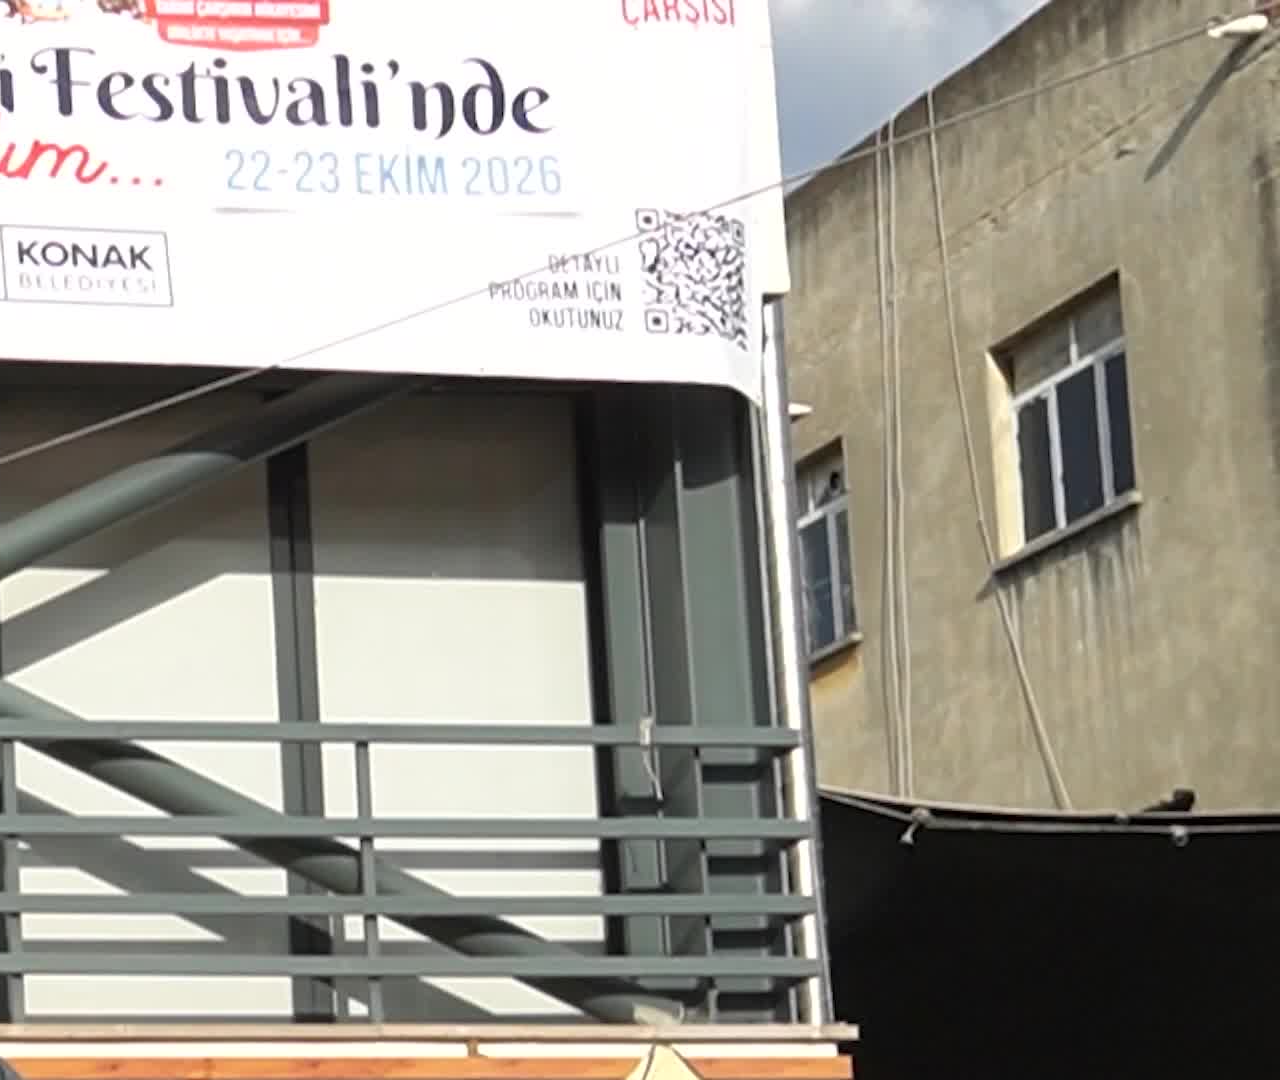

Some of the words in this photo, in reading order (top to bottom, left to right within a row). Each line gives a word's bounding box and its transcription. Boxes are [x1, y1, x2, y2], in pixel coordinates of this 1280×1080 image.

[224, 149, 340, 194] 22-23
[354, 147, 449, 196] EKİM
[461, 154, 562, 196] 2026
[17, 240, 153, 272] KONAK
[547, 253, 620, 274] DETAYLI
[489, 279, 579, 302] PROGRAM
[529, 306, 625, 332] OKUTUNUZ
